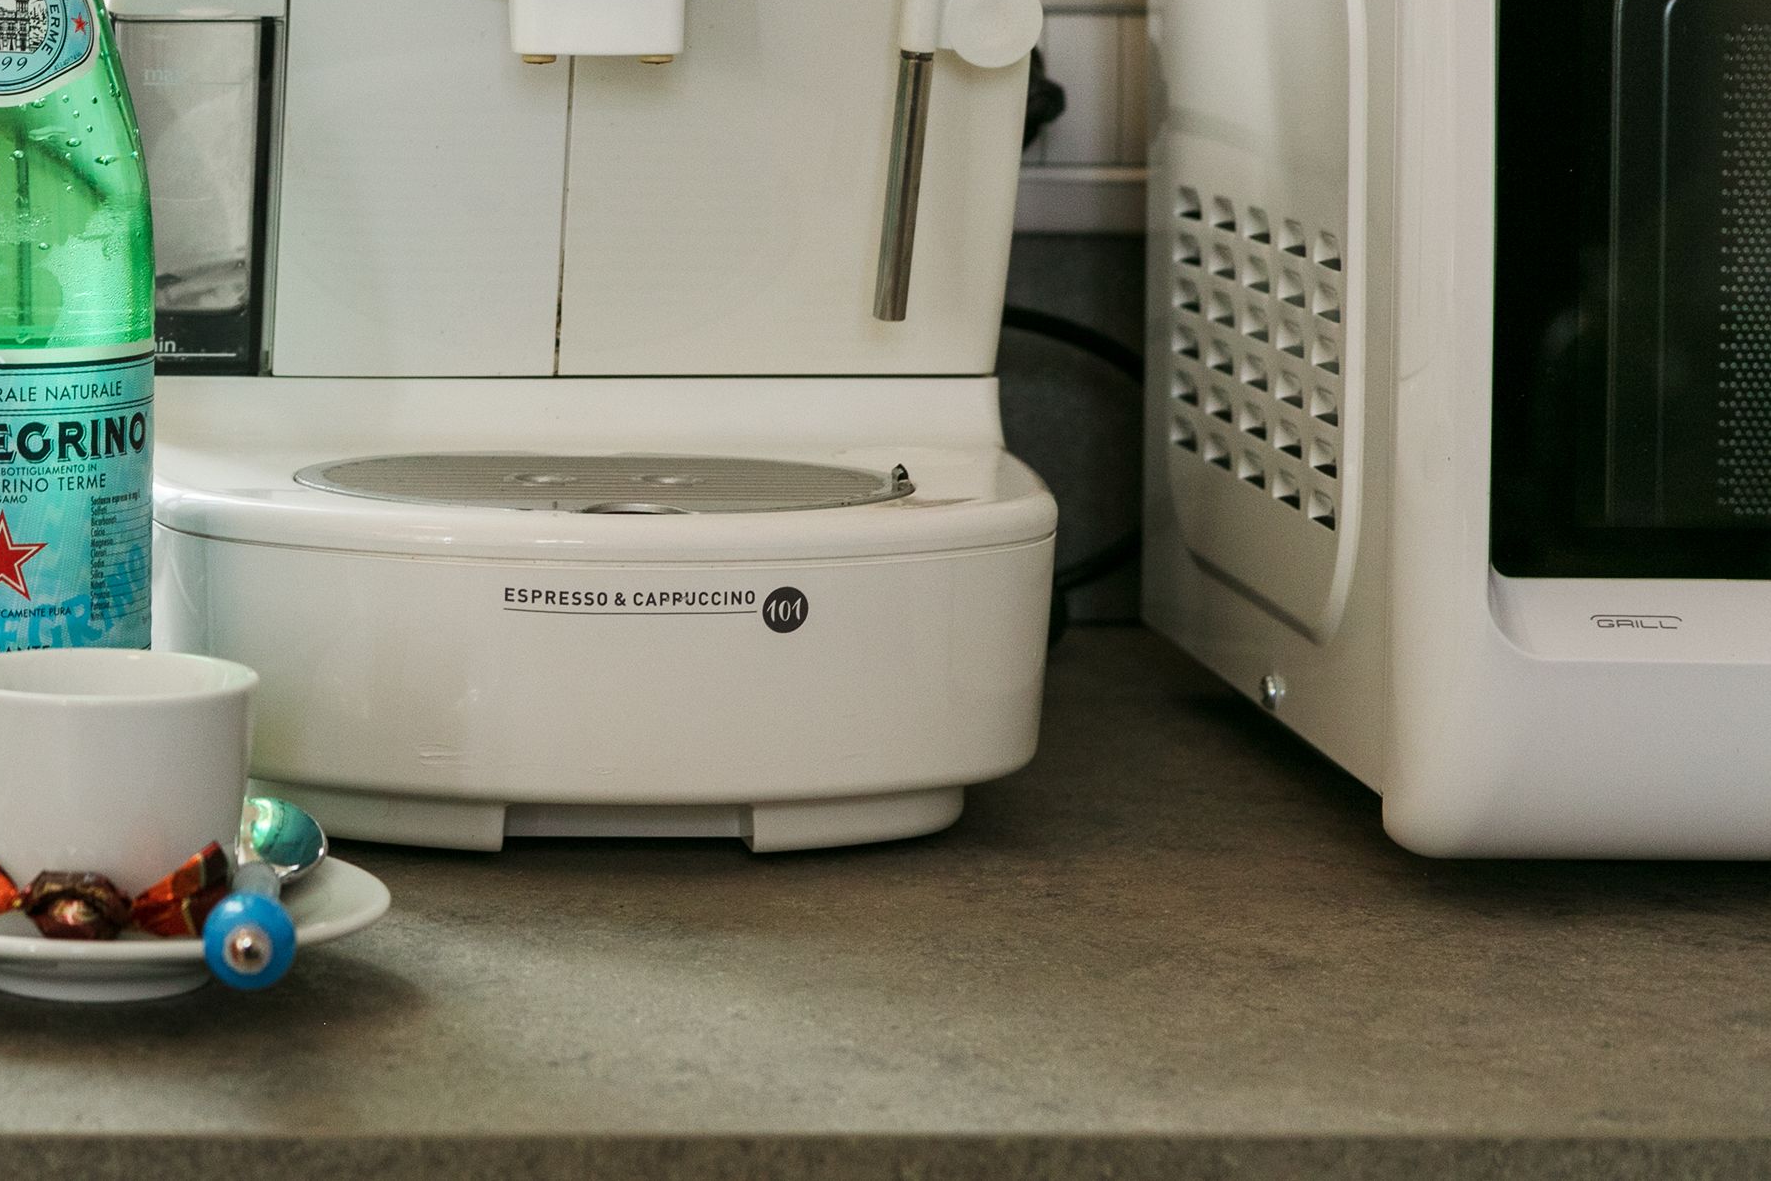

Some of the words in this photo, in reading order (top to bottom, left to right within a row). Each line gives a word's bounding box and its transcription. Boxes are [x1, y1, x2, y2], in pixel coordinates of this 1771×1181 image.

[154, 336, 177, 353] in
[45, 380, 122, 401] NATURALE
[87, 463, 97, 472] IN
[57, 473, 106, 491] TERME
[48, 606, 73, 616] PURA
[504, 587, 608, 606] ESPRESSO
[614, 592, 627, 606] &
[633, 590, 756, 607] CAPPUCCINO
[766, 597, 802, 623] 101
[1596, 619, 1678, 629] GRILL
